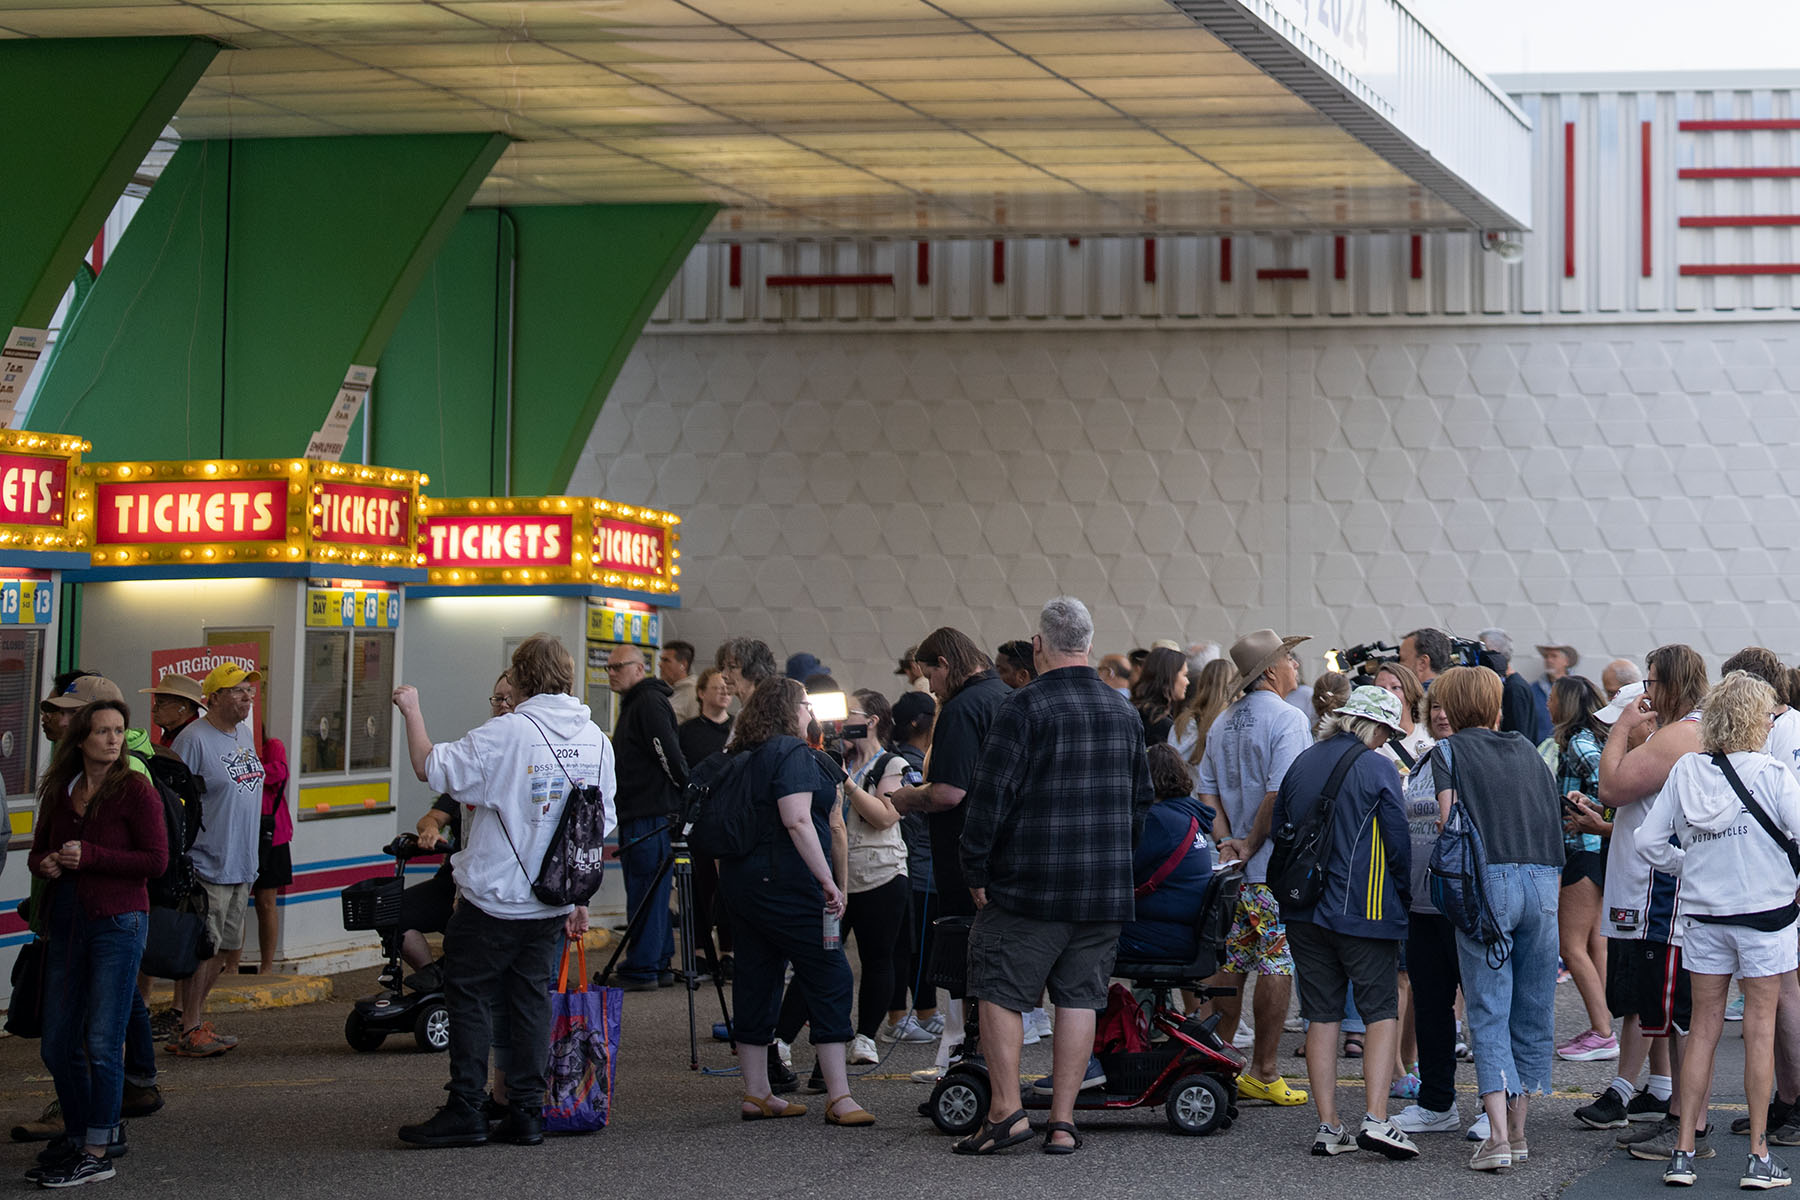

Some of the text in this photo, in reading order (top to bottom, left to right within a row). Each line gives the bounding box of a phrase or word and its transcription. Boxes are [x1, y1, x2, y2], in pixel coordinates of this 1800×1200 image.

[0, 467, 53, 514] ETS
[115, 492, 273, 534] TICKETS
[321, 493, 401, 537] TICKETS
[430, 523, 561, 560] TICKETS
[598, 526, 659, 569] TICKETS
[313, 601, 327, 615] DAY
[556, 748, 579, 759] 2024
